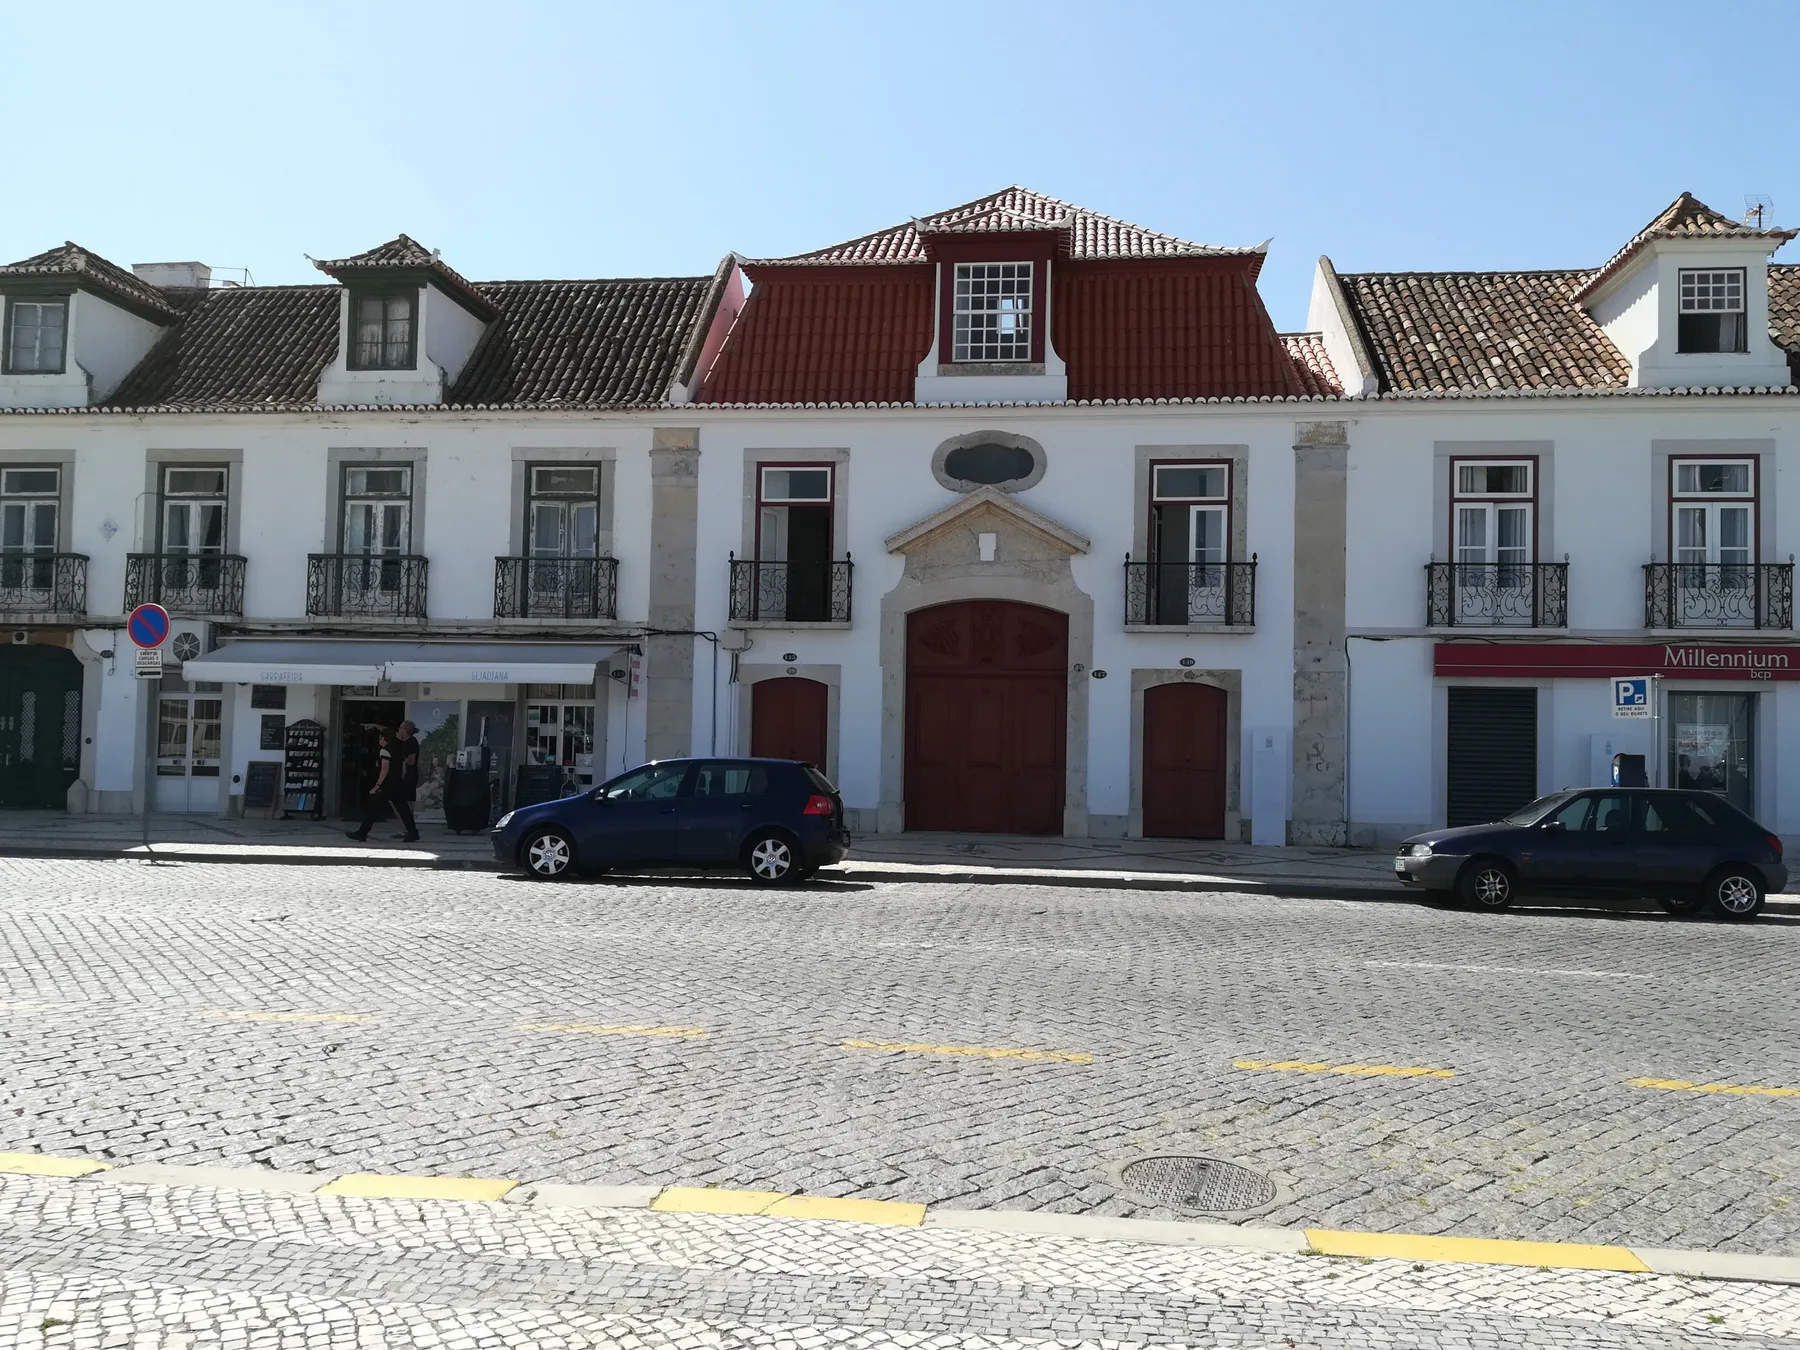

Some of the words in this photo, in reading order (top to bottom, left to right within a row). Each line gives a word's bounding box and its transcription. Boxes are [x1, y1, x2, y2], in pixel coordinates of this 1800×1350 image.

[1664, 645, 1788, 668] Millennium
[1750, 669, 1771, 680] bcp
[1619, 682, 1635, 704] P
